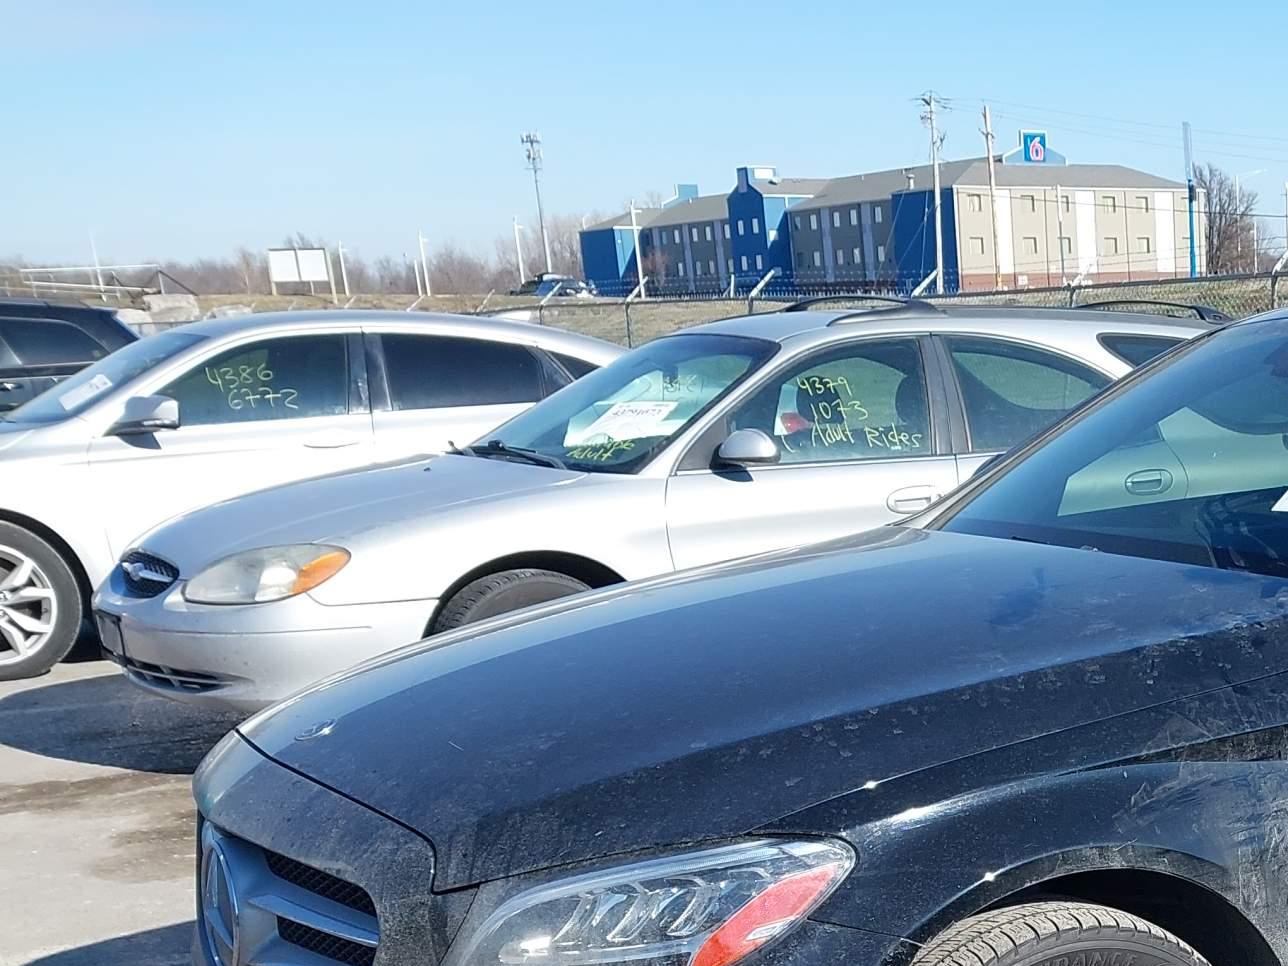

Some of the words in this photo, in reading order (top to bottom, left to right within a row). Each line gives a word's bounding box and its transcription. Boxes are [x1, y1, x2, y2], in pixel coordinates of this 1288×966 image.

[1030, 136, 1044, 161] 6
[204, 363, 274, 393] 4386
[797, 376, 852, 397] 4379
[228, 387, 299, 410] 6772
[810, 398, 869, 420] 1073
[811, 415, 855, 447] Adult
[864, 423, 923, 449] Rides
